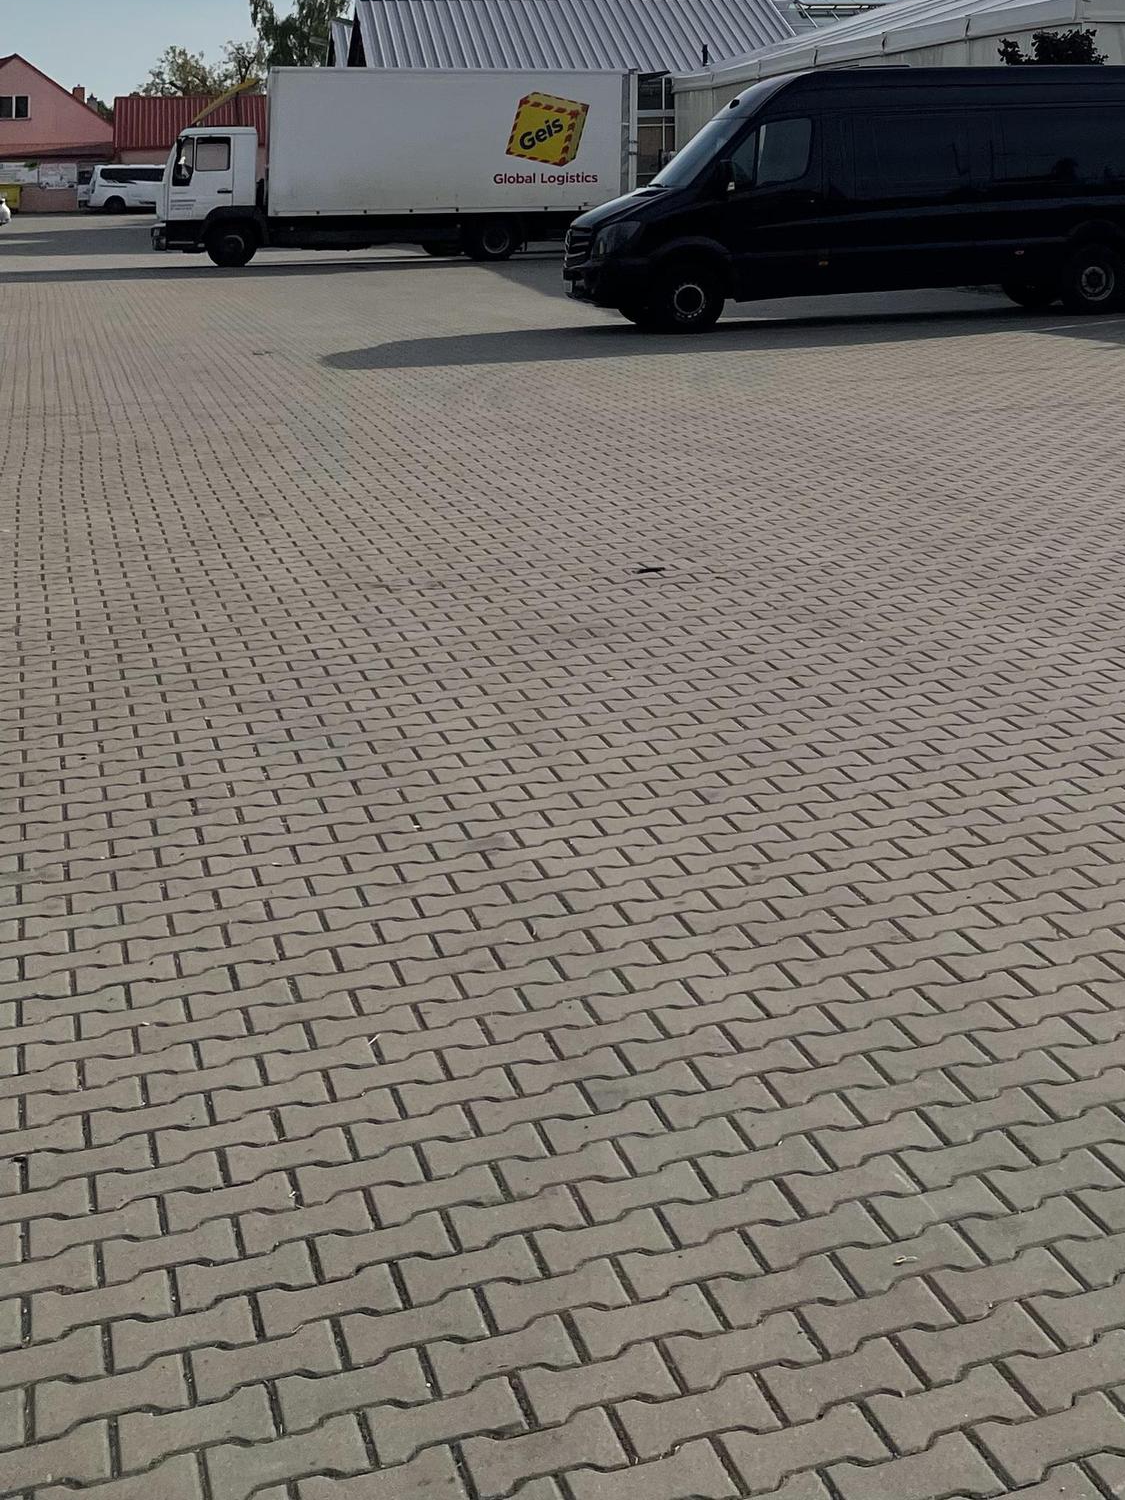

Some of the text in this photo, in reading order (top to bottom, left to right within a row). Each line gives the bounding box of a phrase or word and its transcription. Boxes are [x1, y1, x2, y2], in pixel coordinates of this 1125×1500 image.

[519, 118, 564, 150] Geis
[493, 172, 599, 186] Global Logistics
